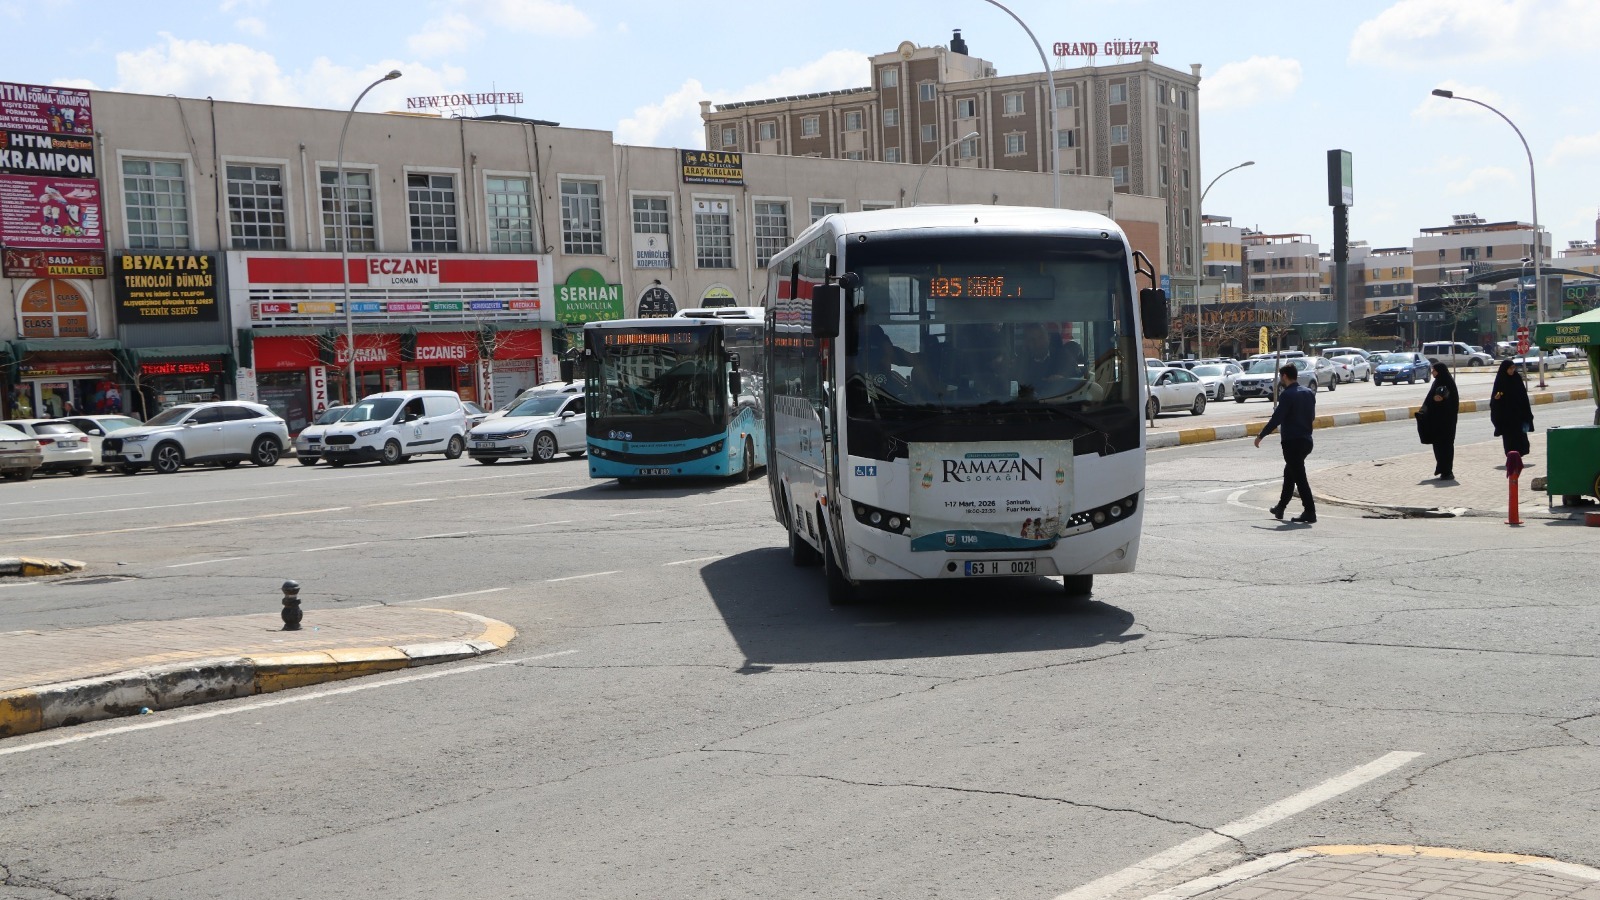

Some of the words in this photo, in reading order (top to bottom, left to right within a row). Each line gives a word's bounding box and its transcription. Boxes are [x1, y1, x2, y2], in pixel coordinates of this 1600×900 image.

[1053, 42, 1097, 56] GRAND
[28, 92, 53, 104] FORMA
[57, 95, 90, 107] KRAMPON
[407, 94, 471, 109] NEWTON
[476, 92, 524, 105] HOTEL
[11, 134, 52, 149] HTM
[700, 152, 740, 165] ASLAN
[686, 167, 705, 176] ARAÇ
[48, 256, 73, 264] SADA
[122, 255, 209, 275] BEYAZTAŞ
[370, 258, 438, 274] ECZANE
[50, 267, 103, 275] ALMALAEIB
[560, 286, 618, 301] SERHAN
[930, 277, 962, 297] 105
[140, 307, 170, 316] TEKNİK
[171, 306, 198, 315] SERVİS
[24, 319, 52, 328] CLASS
[1556, 325, 1580, 334] TOST
[142, 363, 176, 374] TEKNİK
[178, 362, 210, 373] SERVİS
[942, 458, 1044, 482] RAMAZAN
[966, 474, 1018, 482] SOKAĞI
[972, 562, 985, 574] 63
[992, 562, 998, 574] H
[1011, 561, 1034, 573] 0021
